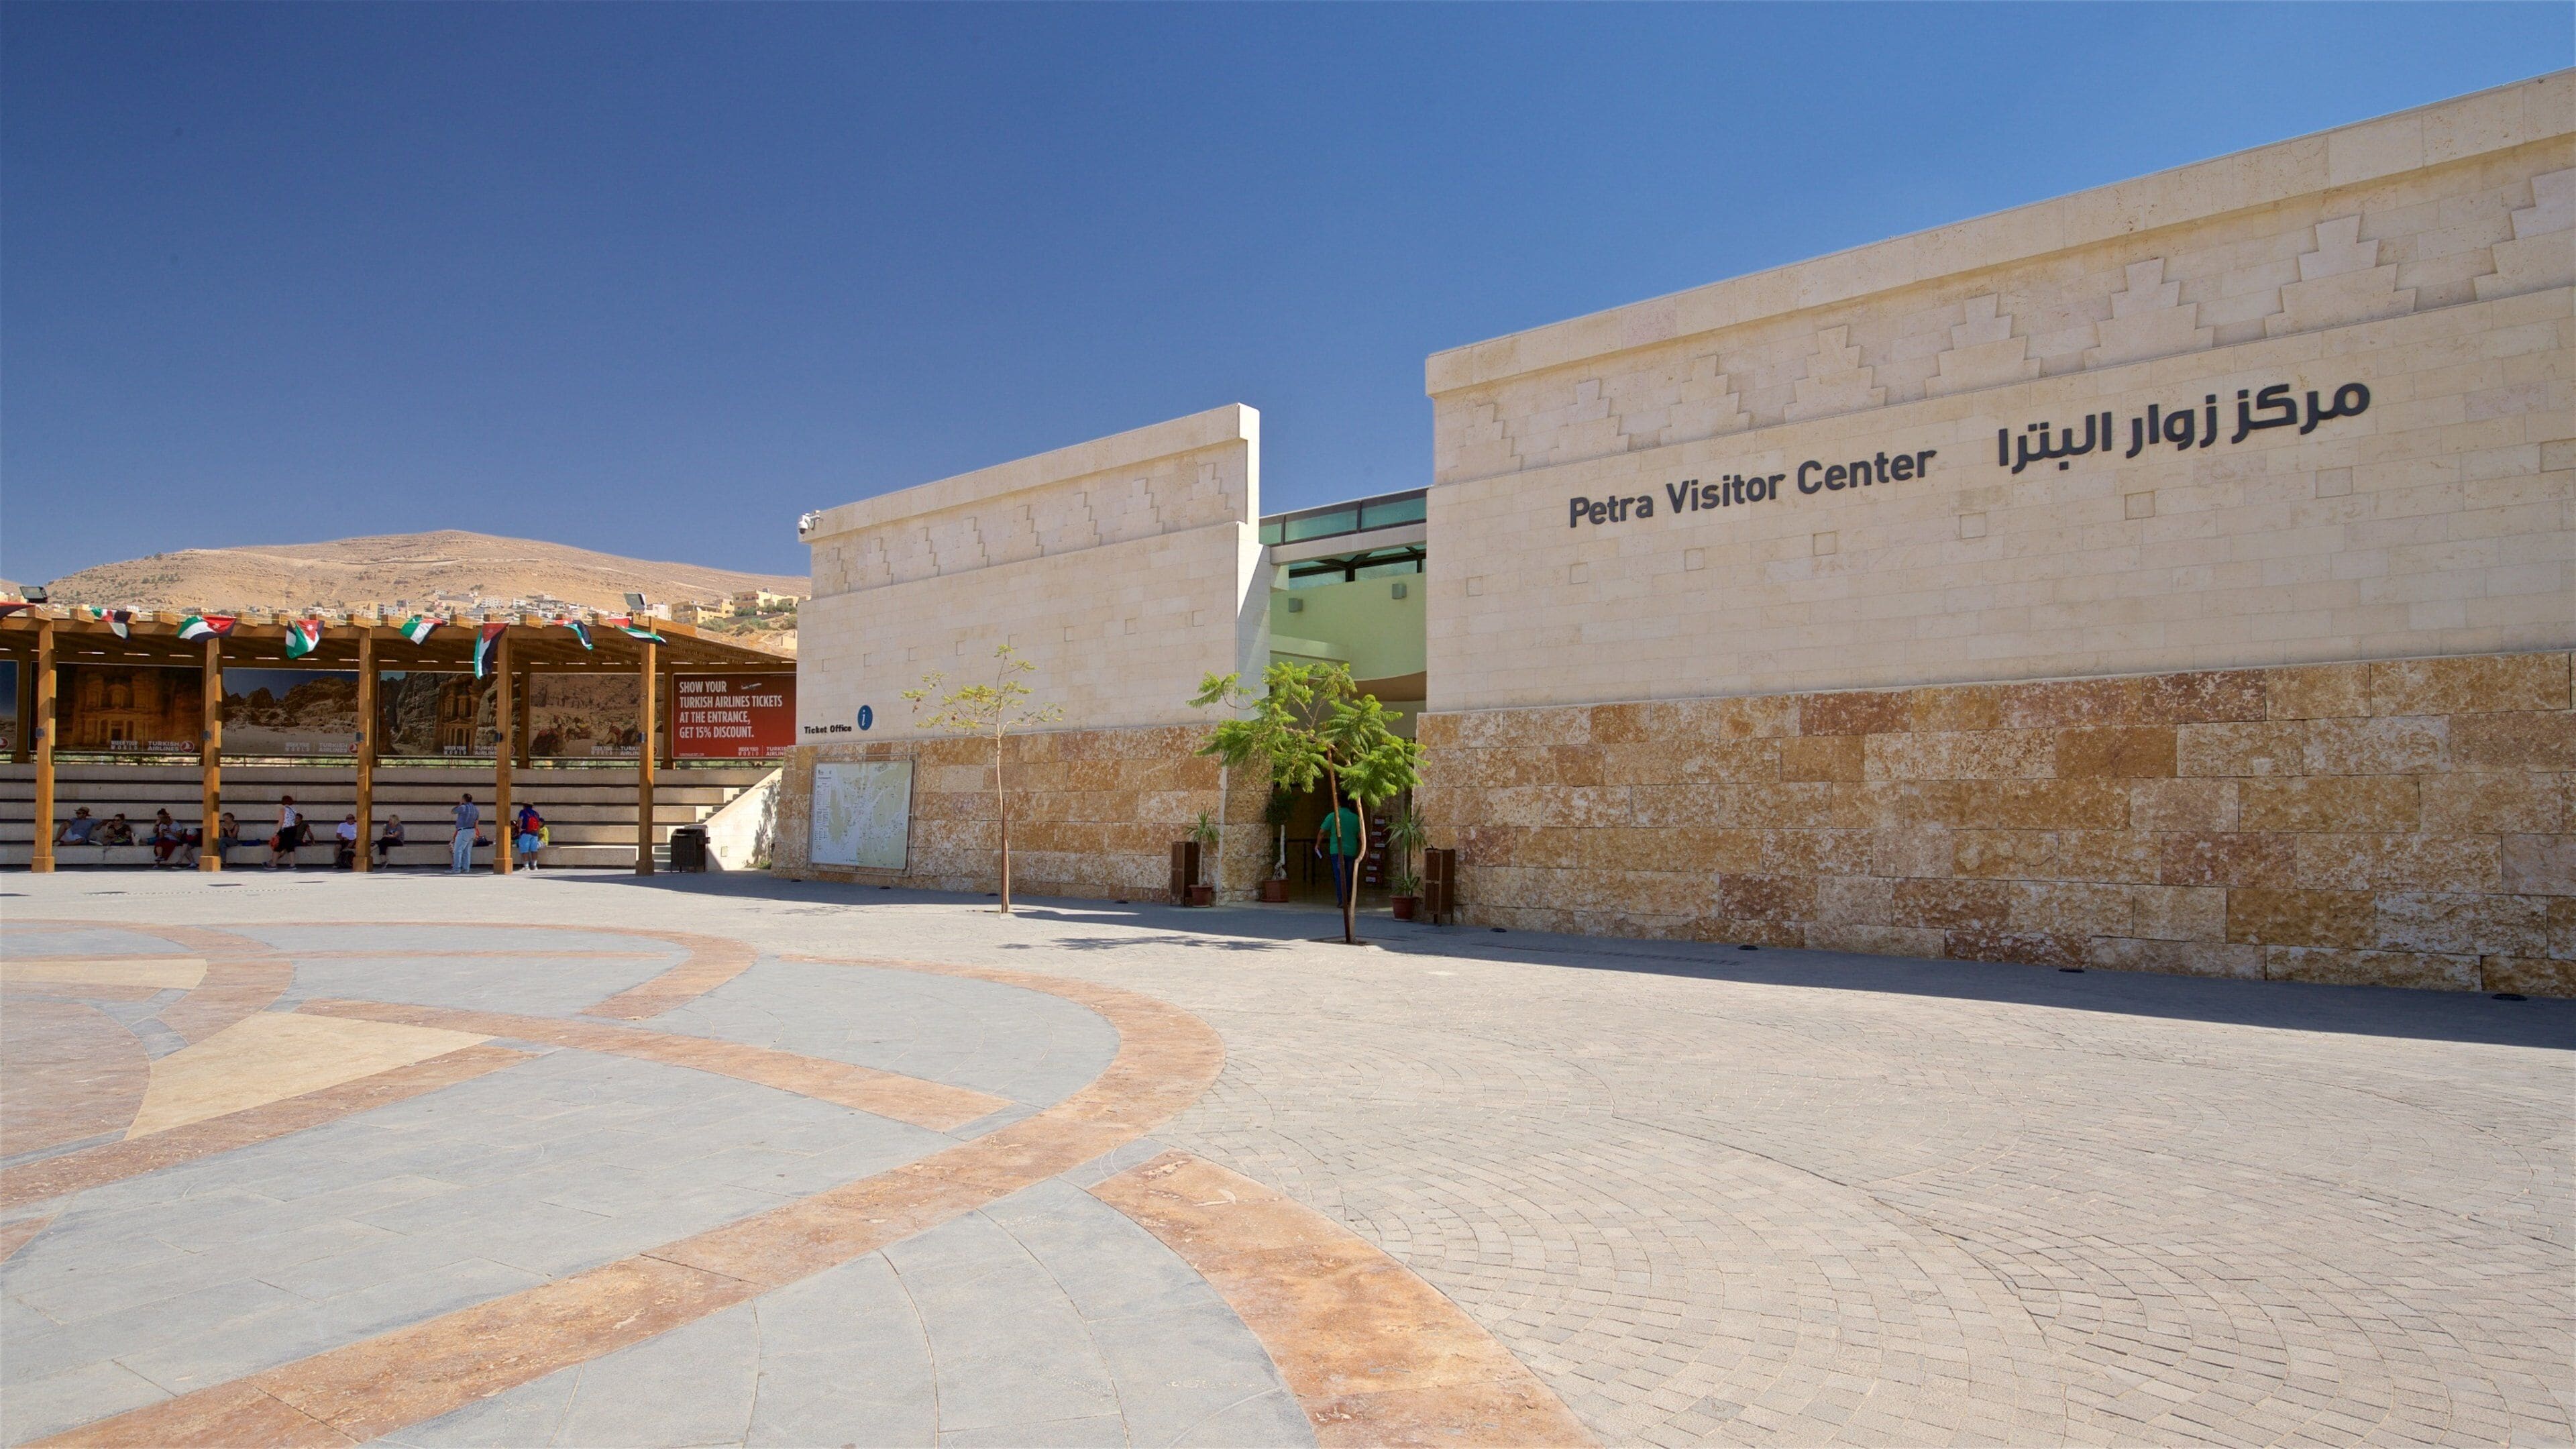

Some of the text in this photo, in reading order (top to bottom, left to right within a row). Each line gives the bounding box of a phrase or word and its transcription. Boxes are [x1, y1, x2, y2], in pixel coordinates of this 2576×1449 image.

[1998, 382, 2371, 475] مركز زوار البترا
[1570, 449, 1937, 529] Petra Visitor Center
[679, 680, 727, 693] SHOW YOUR
[680, 695, 783, 708] TURKISH AIRLINES TICKETS
[679, 710, 751, 724] AT THE ENTRANCE,
[679, 726, 755, 739] GET 15% DISCOUNT.
[804, 724, 852, 734] Ticket Office
